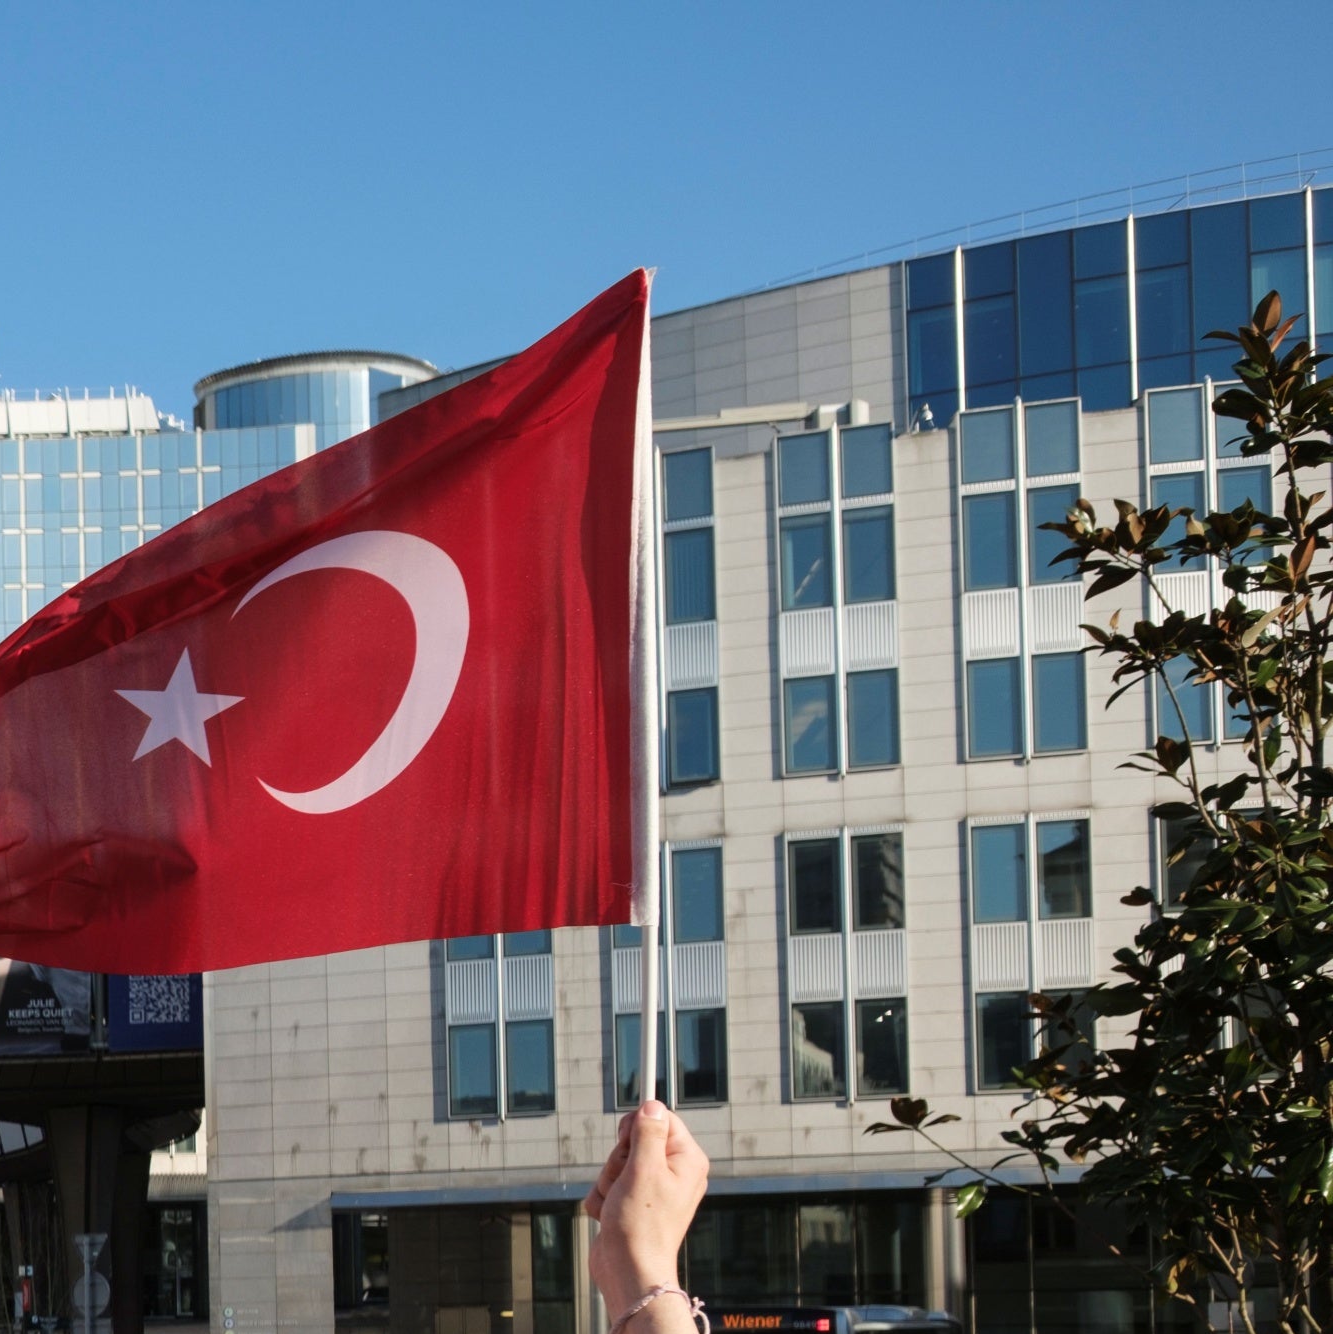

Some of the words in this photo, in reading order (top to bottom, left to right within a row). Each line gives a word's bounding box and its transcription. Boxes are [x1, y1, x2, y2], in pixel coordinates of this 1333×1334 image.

[27, 998, 55, 1008] JULIE
[8, 1008, 40, 1018] KEEPS
[42, 1008, 73, 1017] QUIET
[723, 1314, 782, 1329] Wiener
